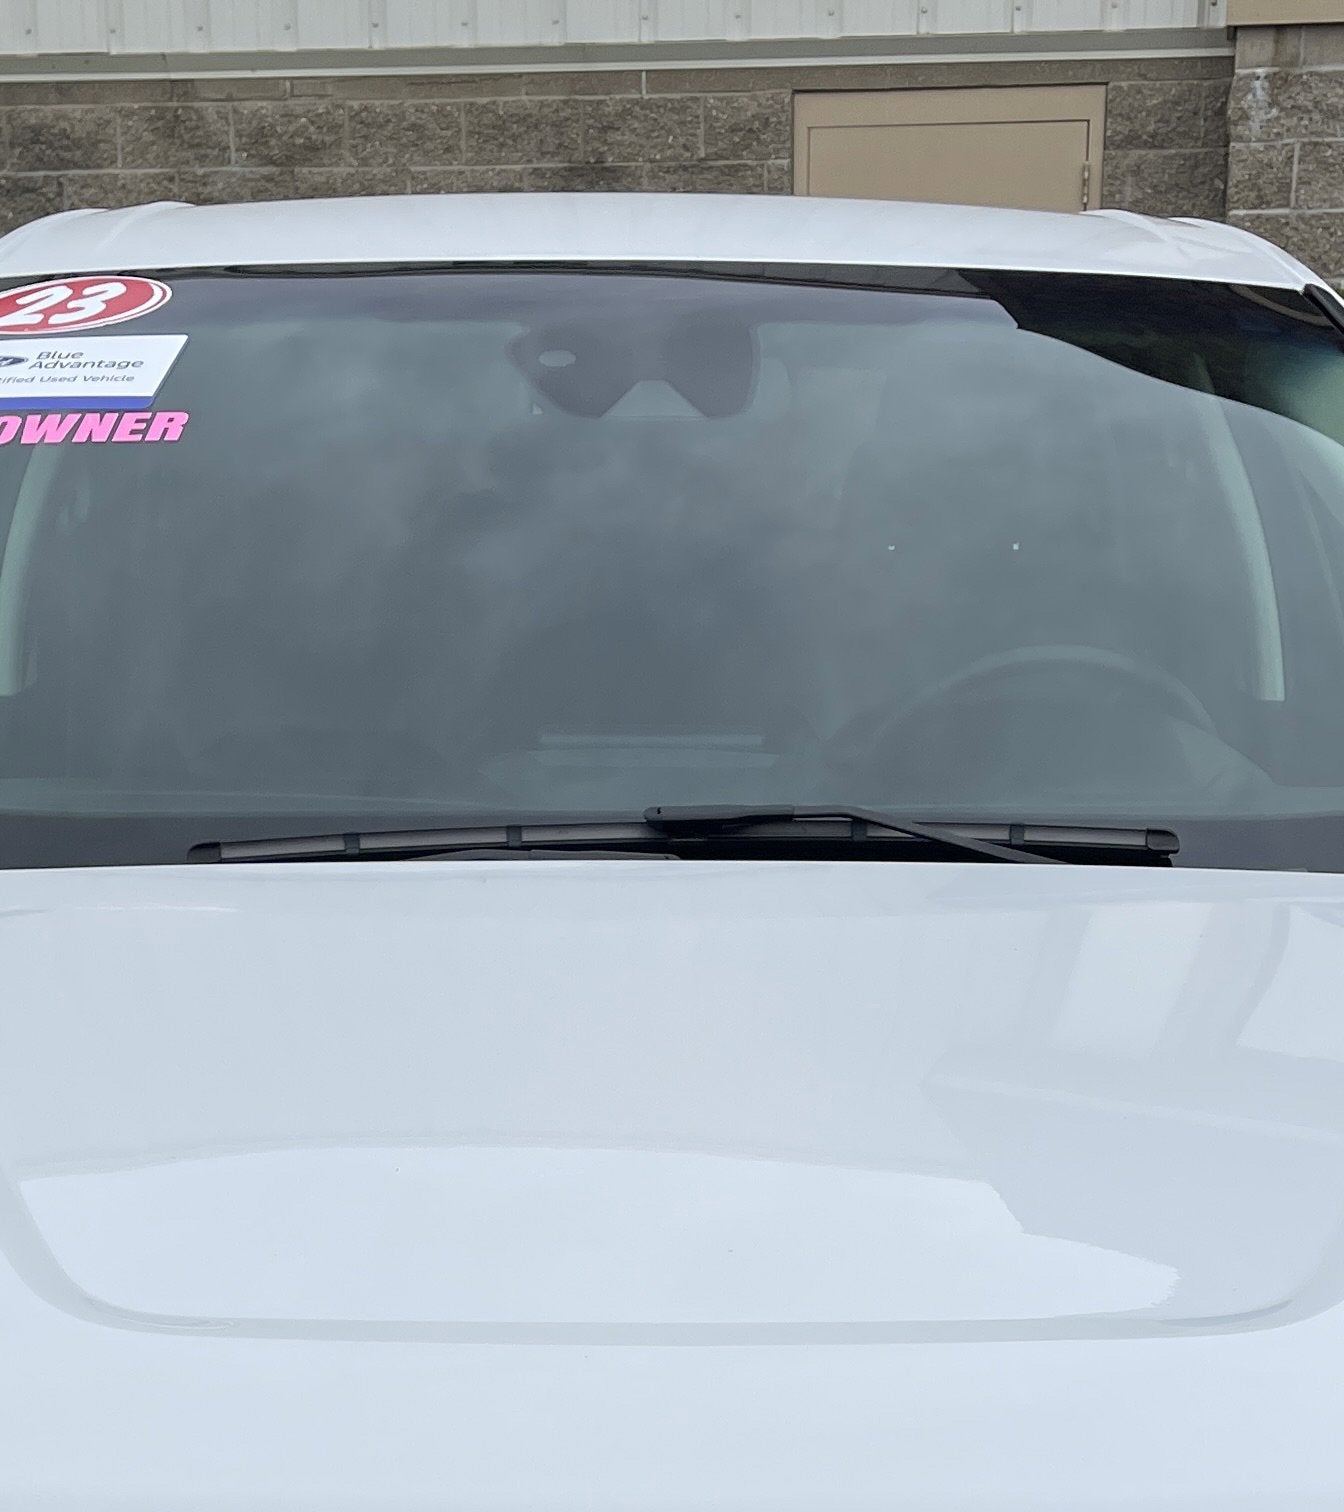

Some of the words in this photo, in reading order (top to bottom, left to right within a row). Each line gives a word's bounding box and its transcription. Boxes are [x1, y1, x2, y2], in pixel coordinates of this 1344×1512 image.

[36, 350, 84, 360] Blue
[27, 360, 145, 370] Advantage
[39, 375, 78, 383] Used
[82, 374, 136, 383] Vehicle
